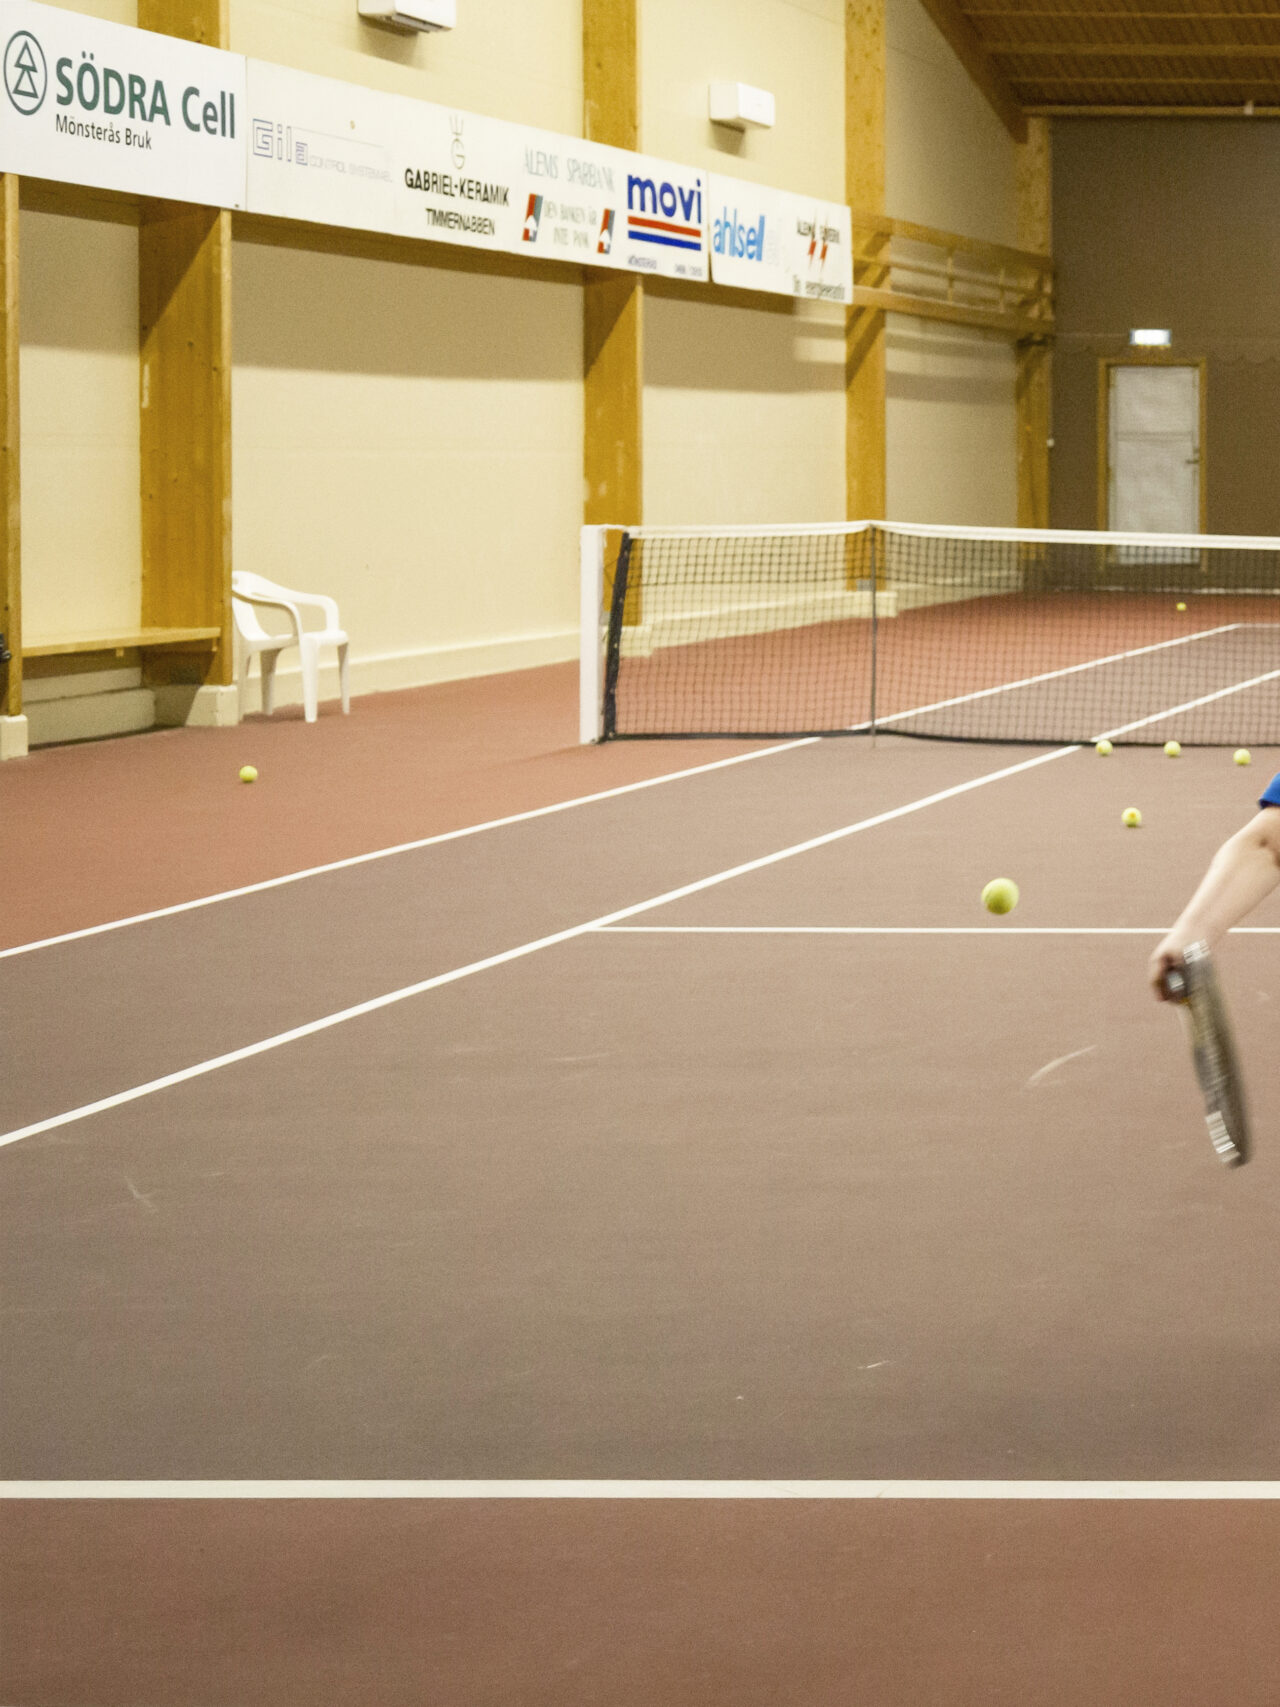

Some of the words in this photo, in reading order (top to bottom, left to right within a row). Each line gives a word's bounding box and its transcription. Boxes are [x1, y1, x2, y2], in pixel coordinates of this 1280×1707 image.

[56, 50, 172, 126] SÖDRA
[181, 86, 236, 140] Cell
[55, 113, 122, 145] Mönsterås
[125, 128, 152, 150] Bruk
[404, 167, 510, 207] GABRIEL-KERAMIK
[627, 173, 702, 224] movi
[425, 207, 496, 236] TIMMERNABBEN
[713, 206, 766, 262] ahlsell
